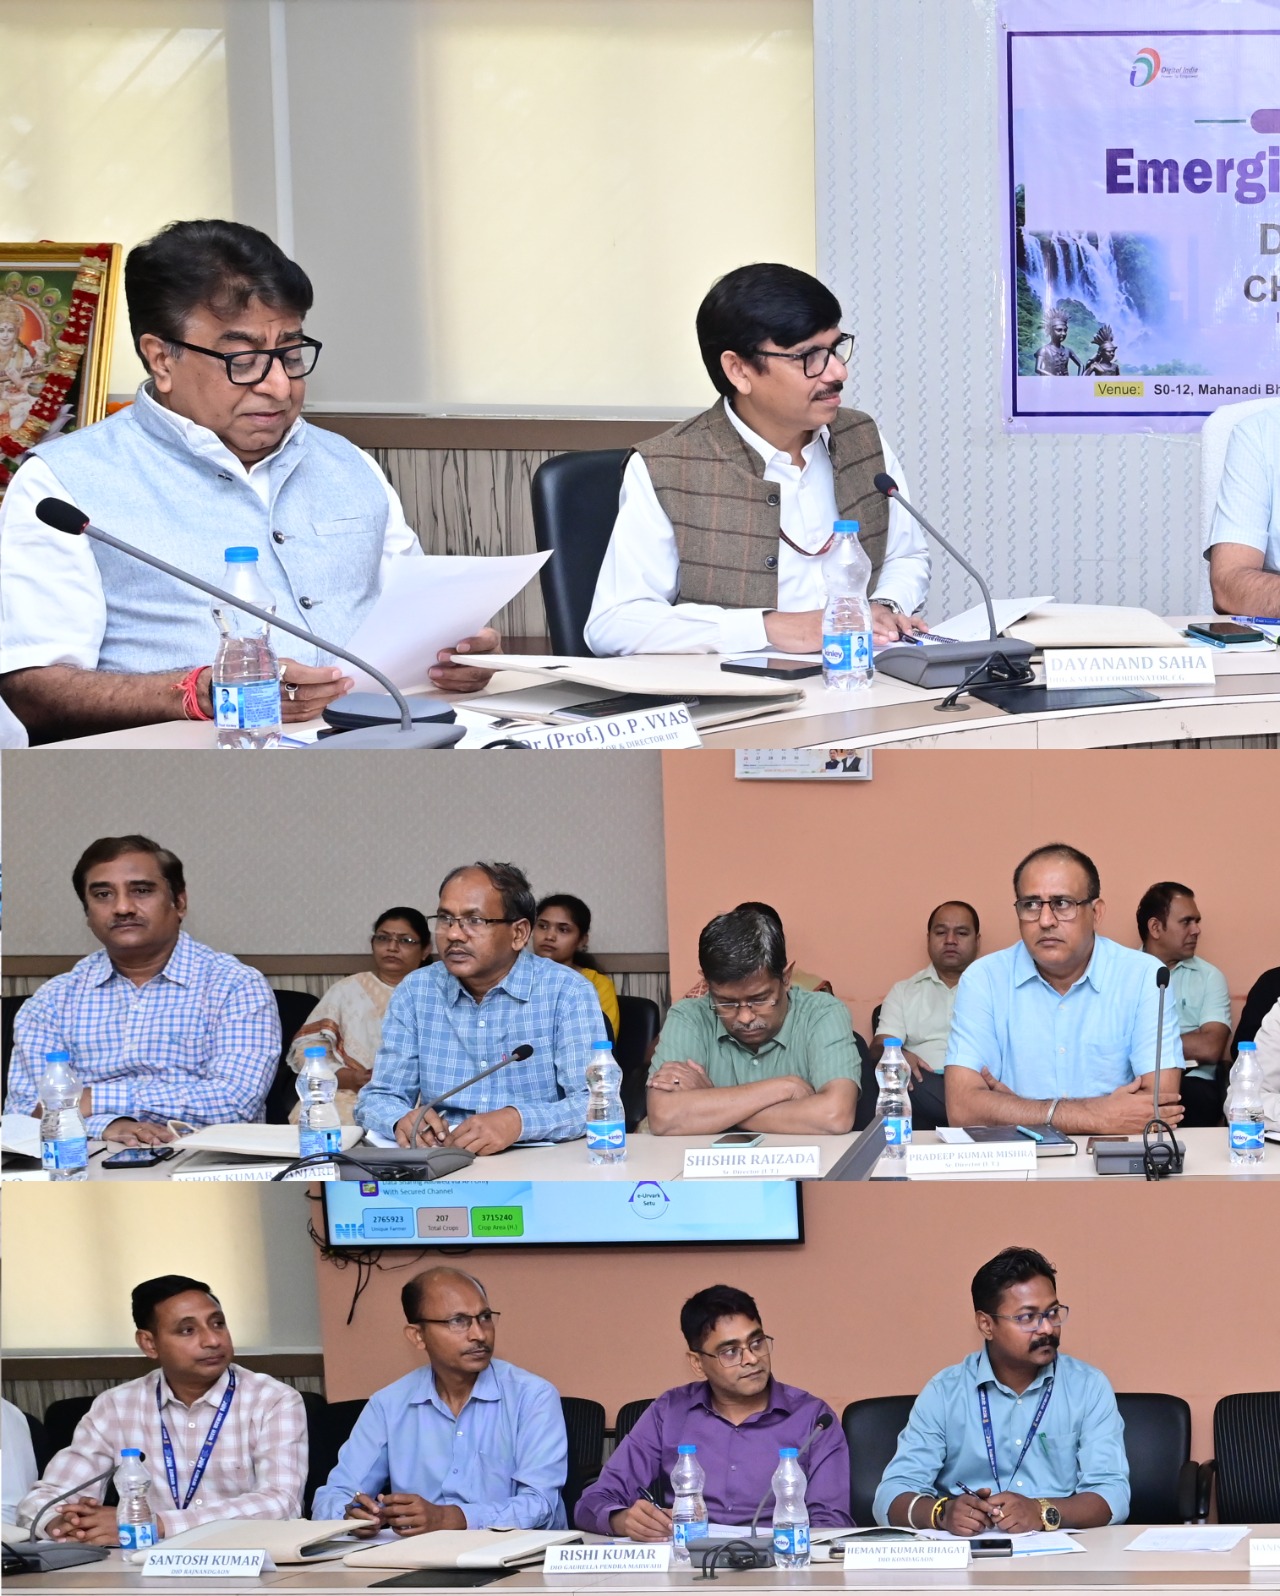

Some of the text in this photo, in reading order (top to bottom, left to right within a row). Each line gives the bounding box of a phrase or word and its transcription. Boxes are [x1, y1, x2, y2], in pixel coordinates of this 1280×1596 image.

[1161, 66, 1199, 74] Digital India
[1098, 383, 1141, 396] Venue:
[1198, 383, 1261, 395] Mahanadi
[1051, 655, 1207, 672] DAYANAND SAHA
[607, 708, 690, 738] O. P. VYAS
[626, 733, 665, 749] DIRECTOR
[686, 1152, 816, 1167] SHISHIR RAIZADA
[909, 1149, 1034, 1162] PRADEEP KUMAR MISHRA
[224, 1171, 274, 1181] KUMAR
[559, 1548, 656, 1561] RISHI KUMAR
[847, 1546, 967, 1555] HEMANT KUMAR BHAGAT
[148, 1554, 260, 1567] SANTOSH KUMAR
